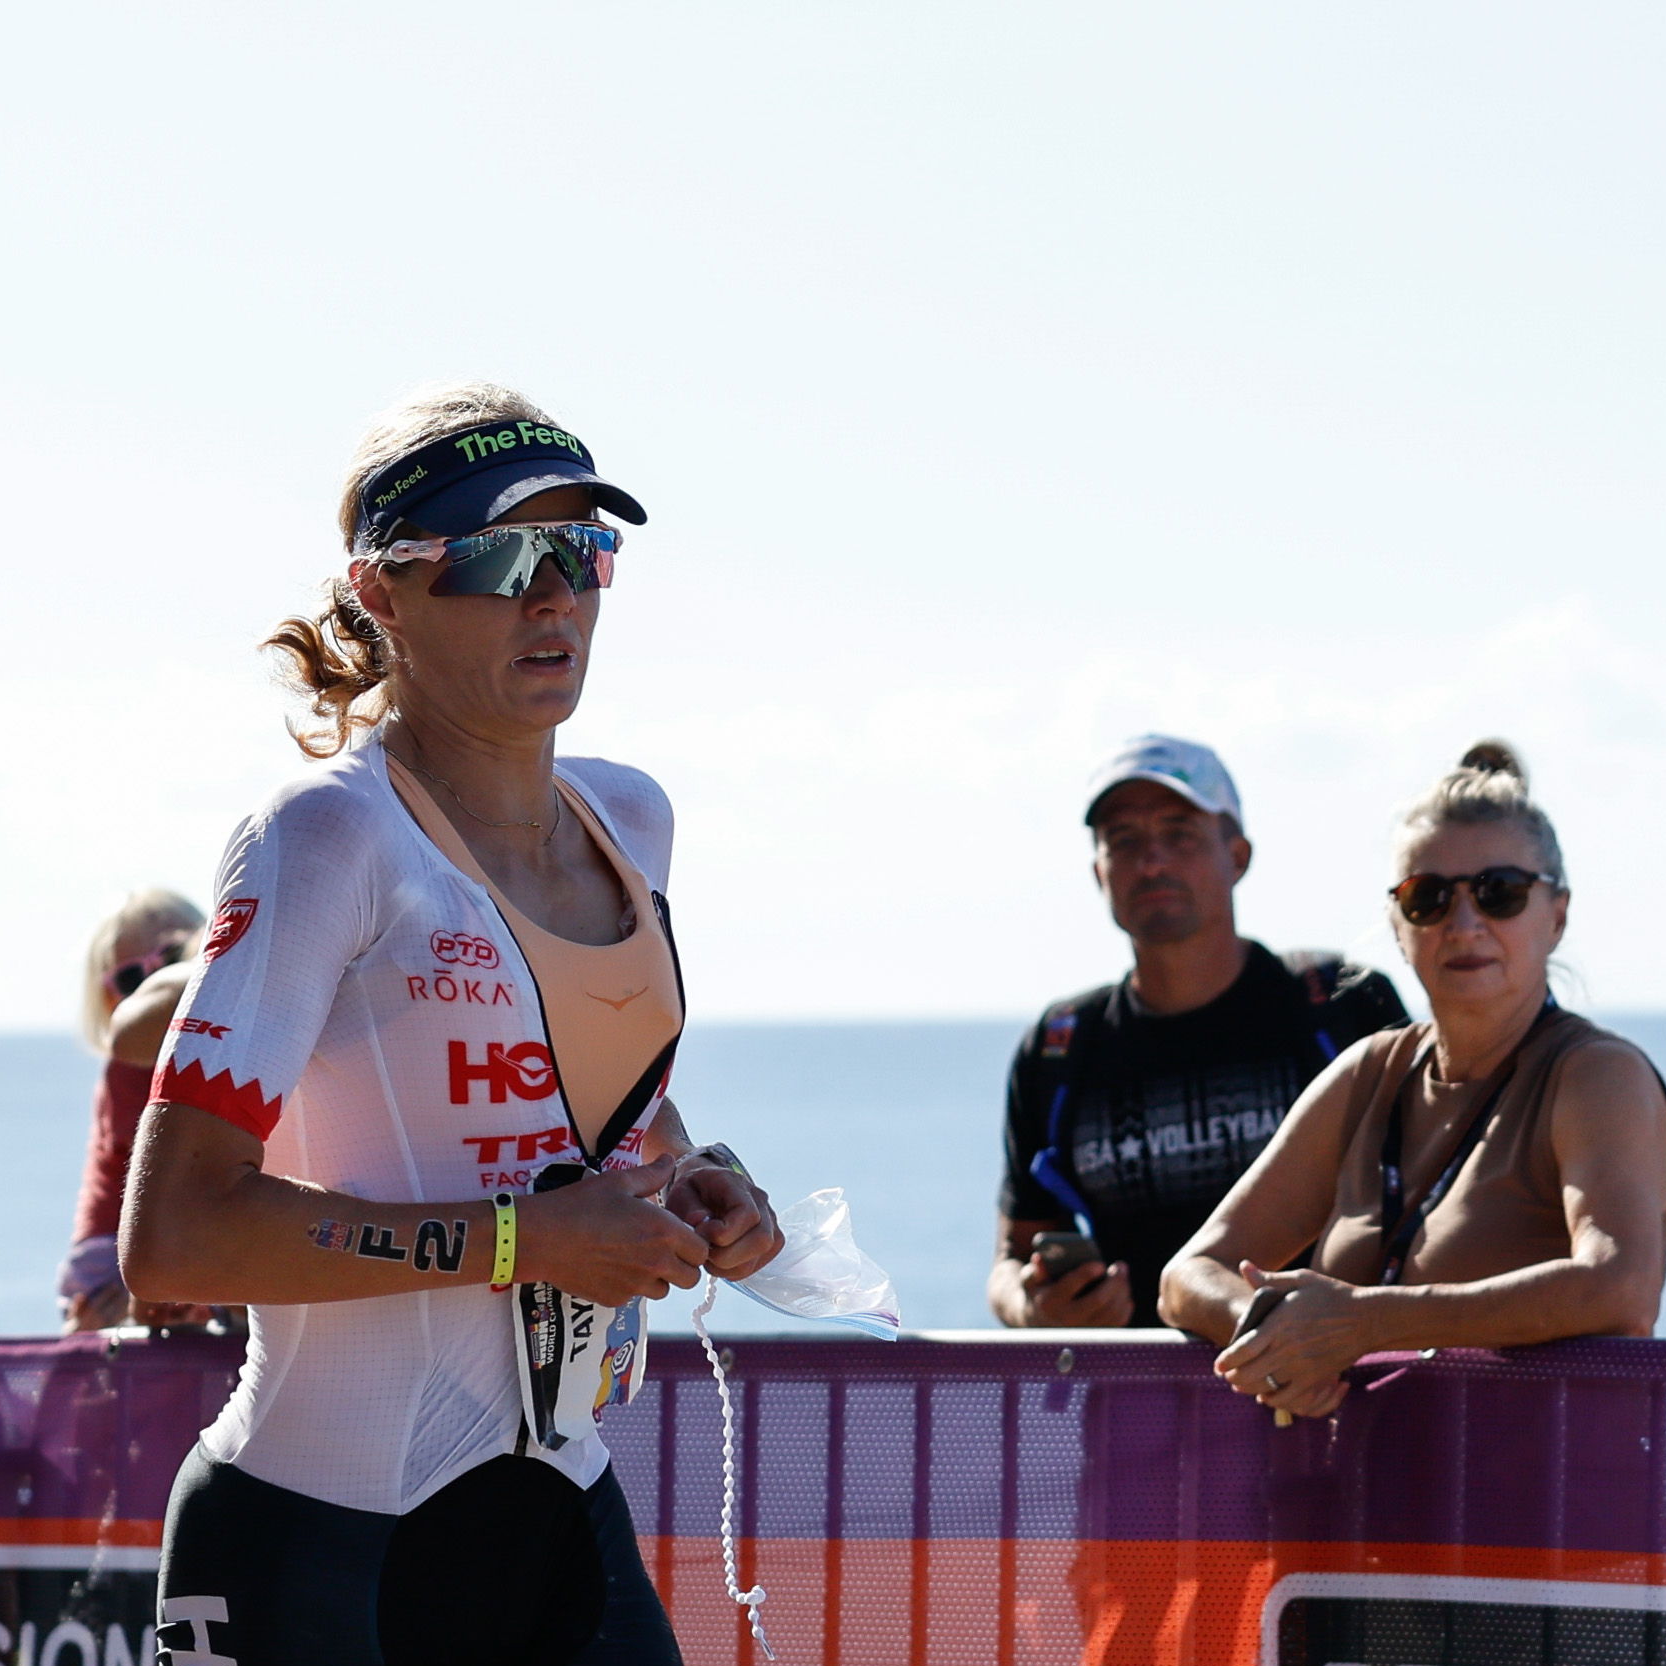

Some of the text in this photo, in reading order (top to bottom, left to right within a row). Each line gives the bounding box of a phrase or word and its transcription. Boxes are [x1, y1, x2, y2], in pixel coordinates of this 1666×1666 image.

[454, 421, 583, 463] The Feed.
[375, 464, 429, 509] The Feed.
[448, 1040, 559, 1104] HO
[412, 1218, 469, 1274] 2
[545, 1324, 558, 1365] WORLD
[569, 1295, 594, 1364] TAY
